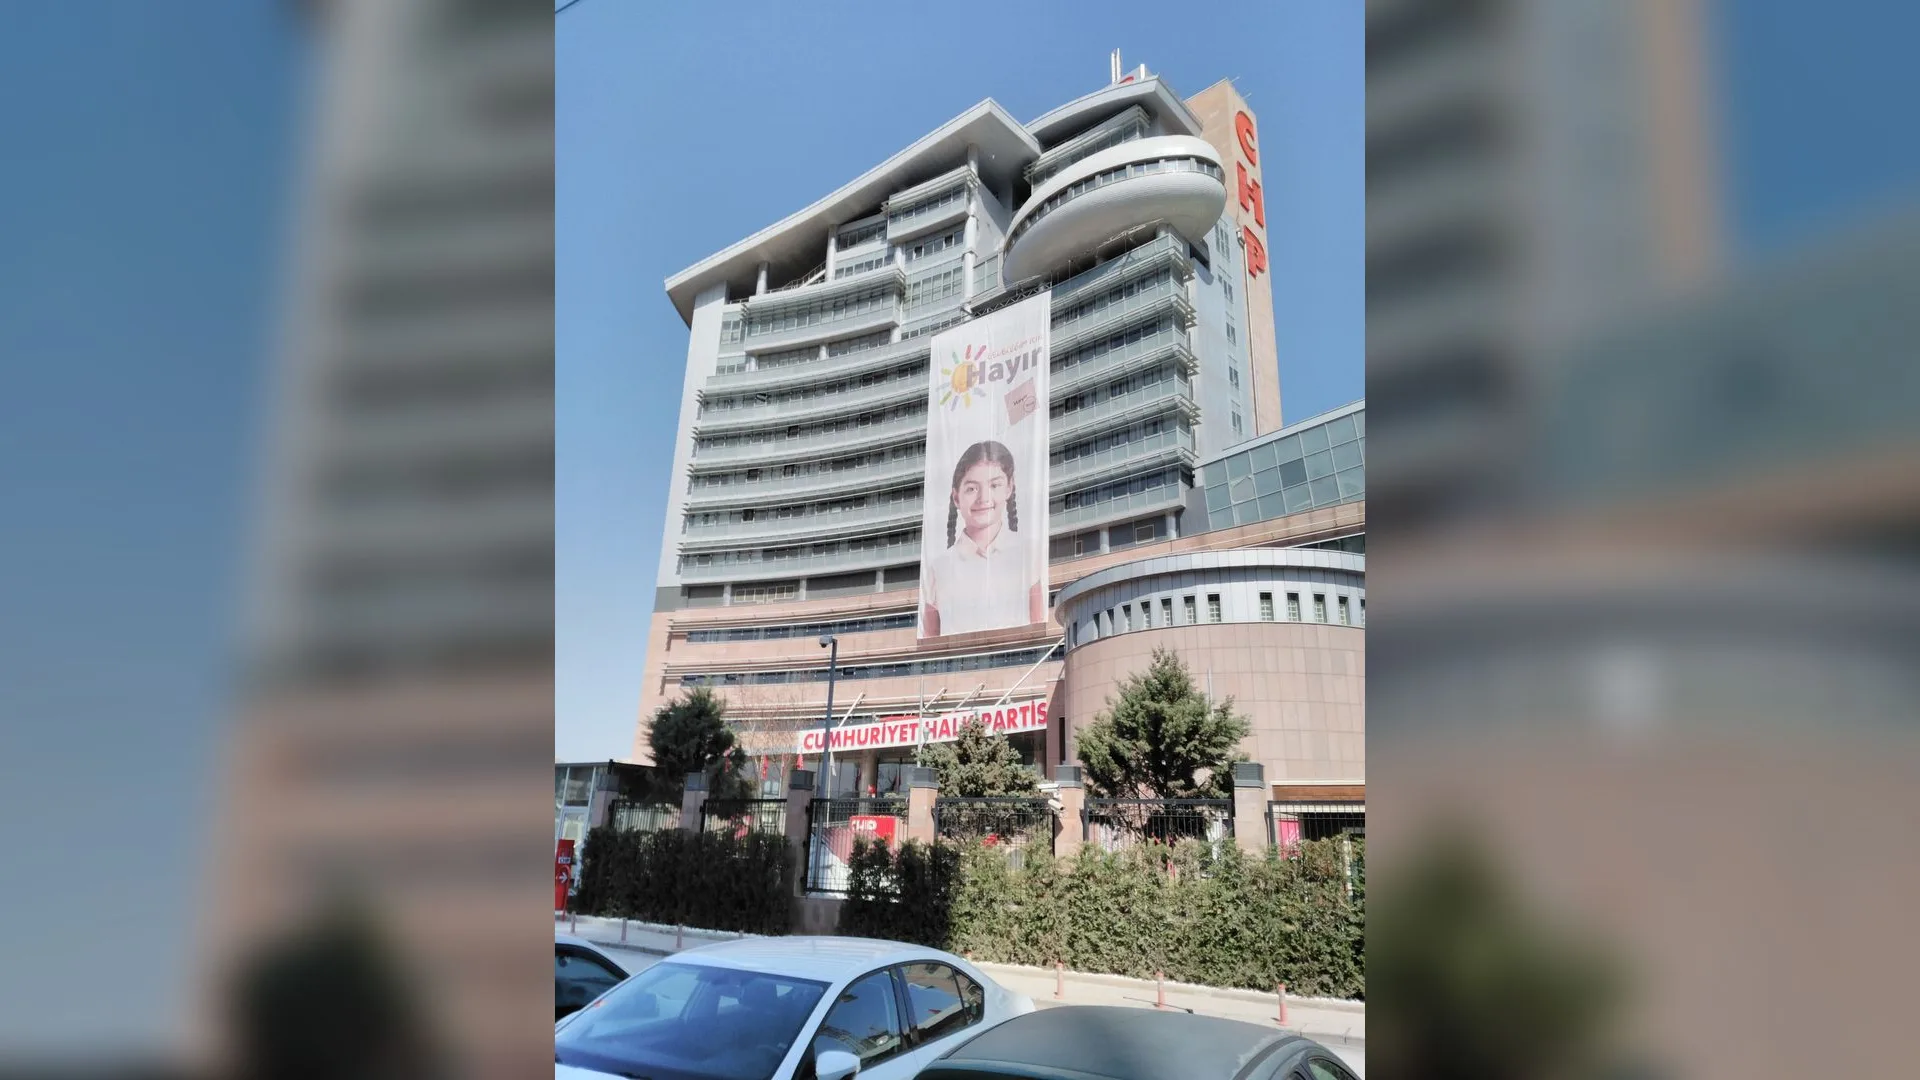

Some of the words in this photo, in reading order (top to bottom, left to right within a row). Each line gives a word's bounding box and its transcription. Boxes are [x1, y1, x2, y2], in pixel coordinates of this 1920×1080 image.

[1235, 110, 1266, 279] CHP
[966, 346, 1043, 388] Hayır
[803, 722, 919, 750] CUMHURİYET
